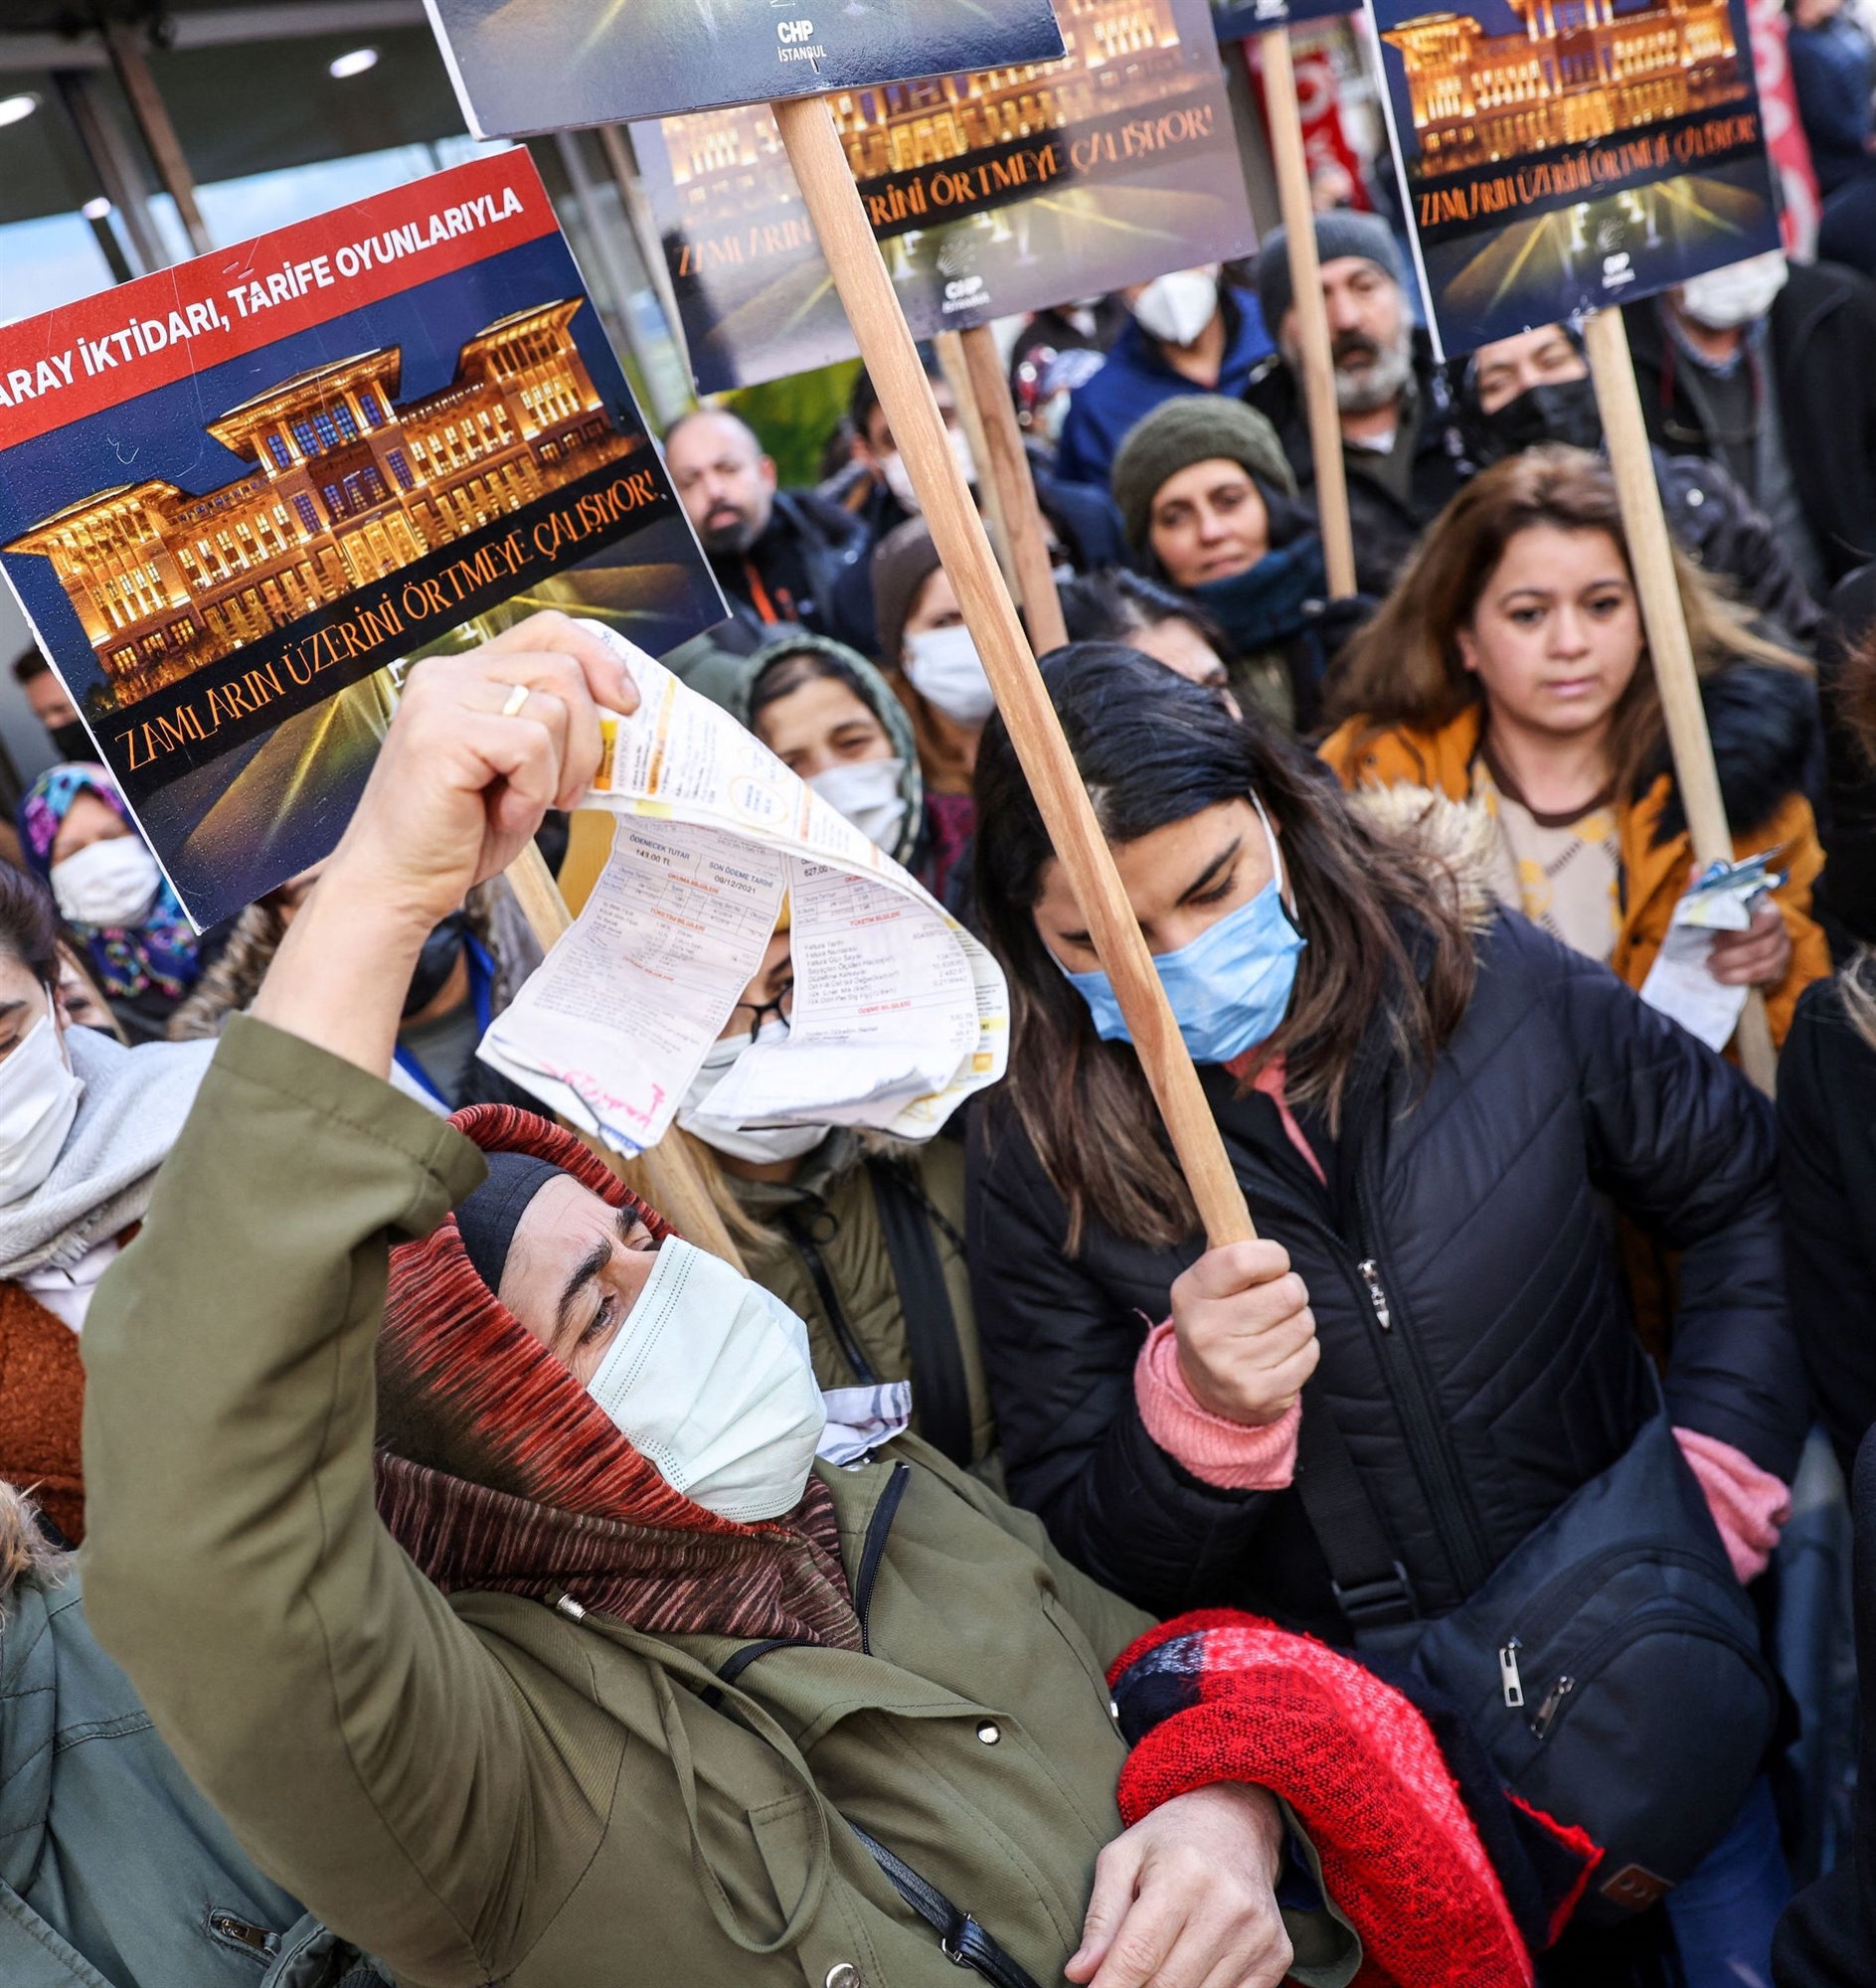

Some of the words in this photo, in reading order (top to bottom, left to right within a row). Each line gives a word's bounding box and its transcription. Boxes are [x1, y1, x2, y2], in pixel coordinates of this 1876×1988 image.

[777, 20, 814, 44] CHP
[777, 45, 827, 63] İSTANBUL
[863, 177, 929, 227] RİNİ
[77, 298, 232, 377] İKTİDARI,
[227, 254, 335, 319] TARİFE
[336, 187, 524, 277] OYUNLARIYLA
[113, 663, 288, 772] ZAMLARIN
[281, 592, 405, 686] ÜZERİNİ
[403, 529, 535, 621] ÖRTMEYE
[533, 470, 658, 562] ÇALIŞIYOR!
[629, 834, 667, 854] ÖDENECEK
[667, 847, 690, 861] TUTAR
[709, 861, 724, 873] SON
[725, 866, 750, 882] ÖDEME
[751, 874, 774, 890] TARİHİ
